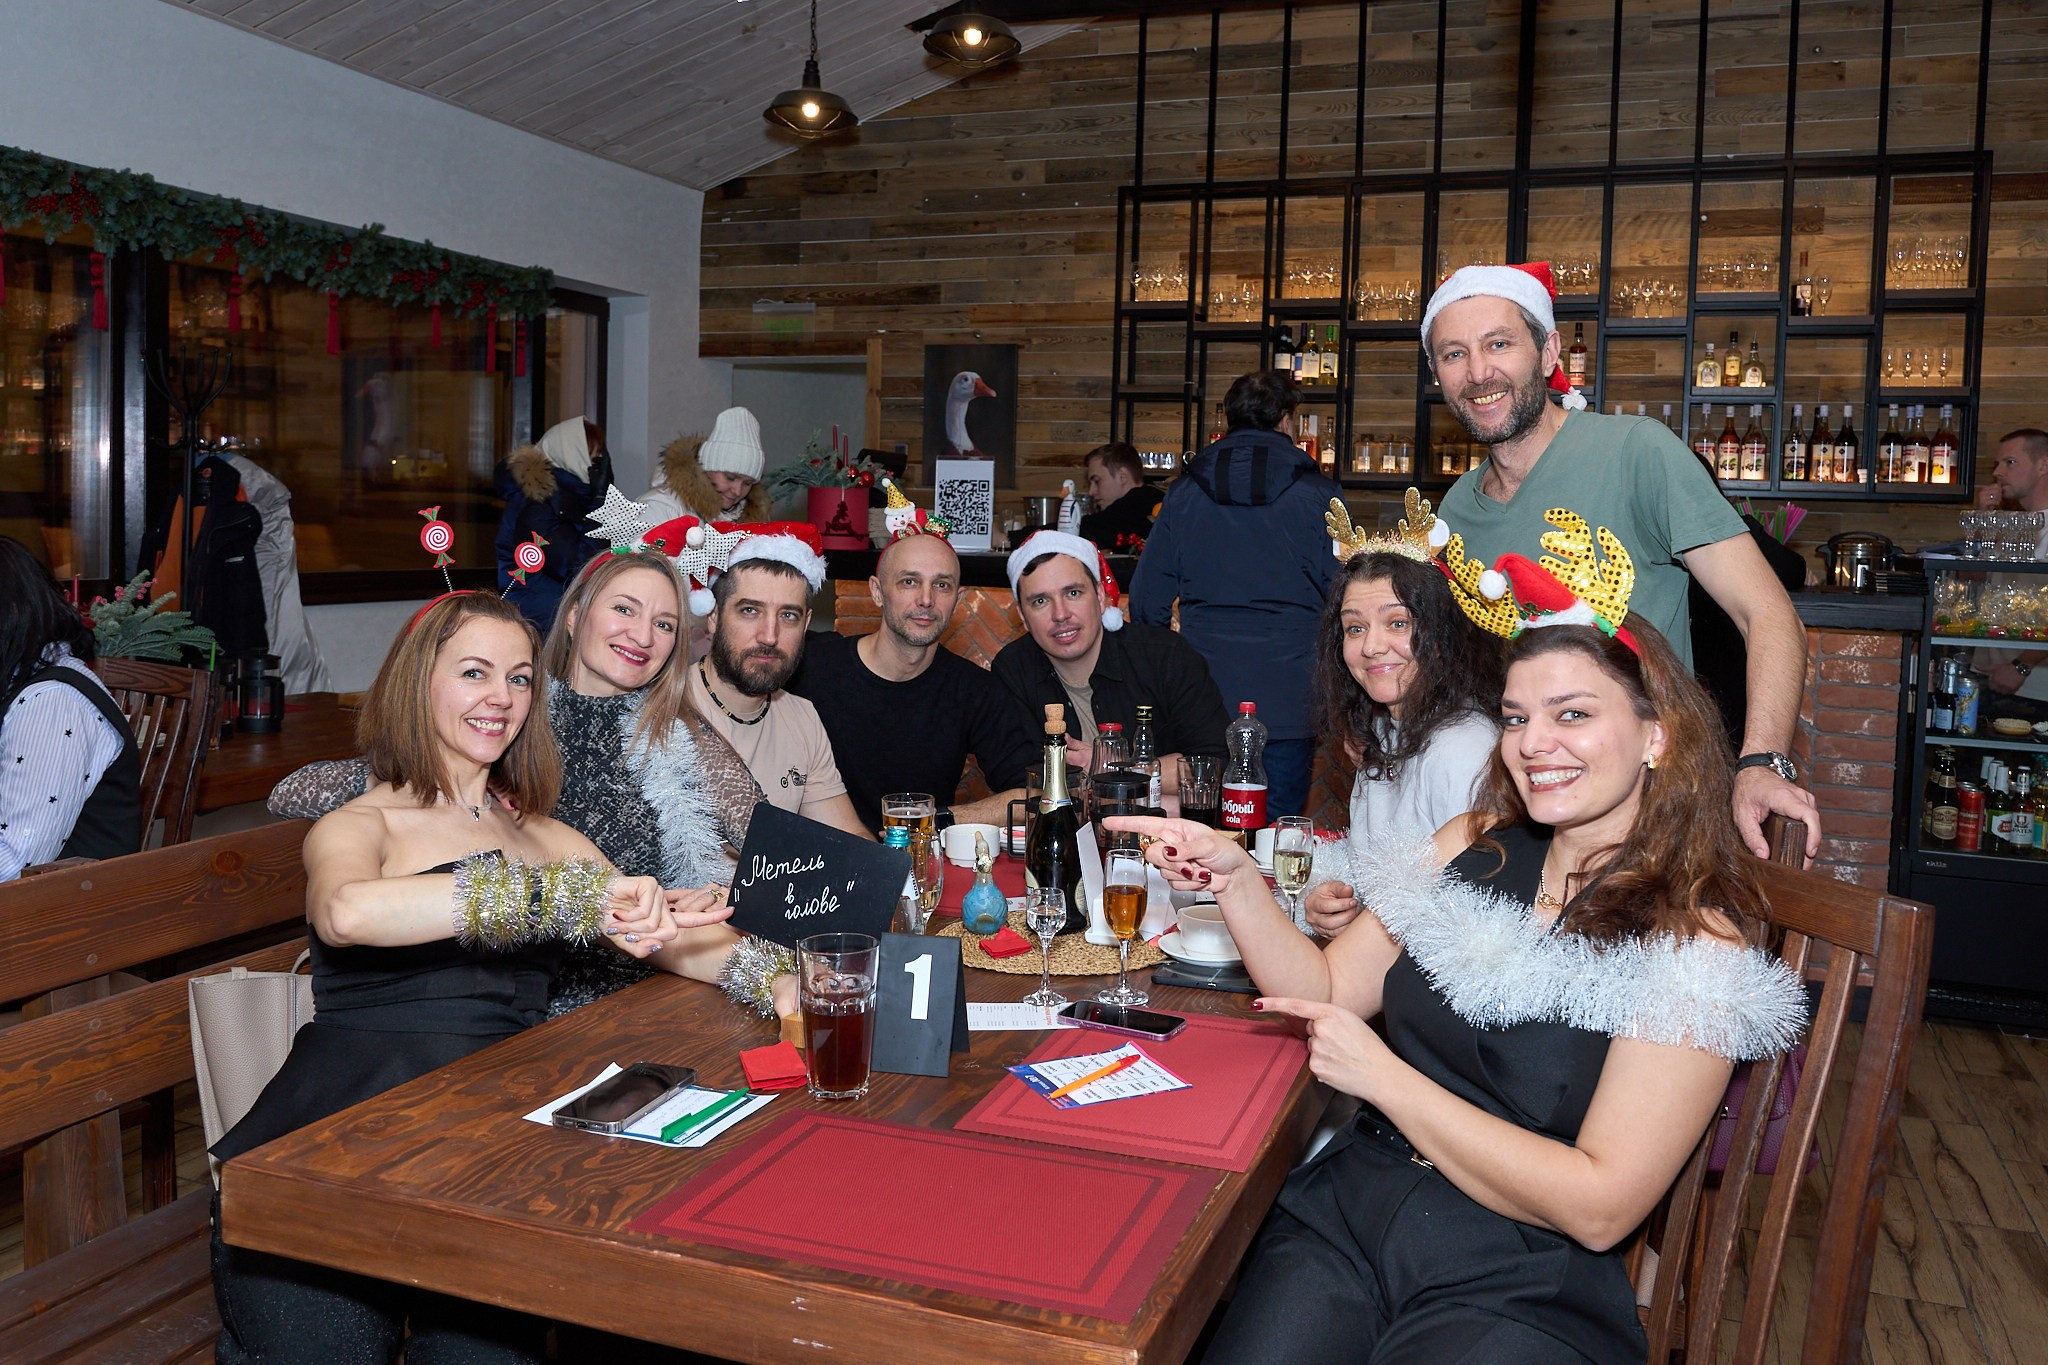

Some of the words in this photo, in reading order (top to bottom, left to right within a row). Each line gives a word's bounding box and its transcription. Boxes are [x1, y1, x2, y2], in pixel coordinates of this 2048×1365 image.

[1226, 816, 1241, 824] cola
[2012, 827, 2033, 835] PATEN
[785, 882, 795, 904] в
[904, 953, 933, 1020] 1
